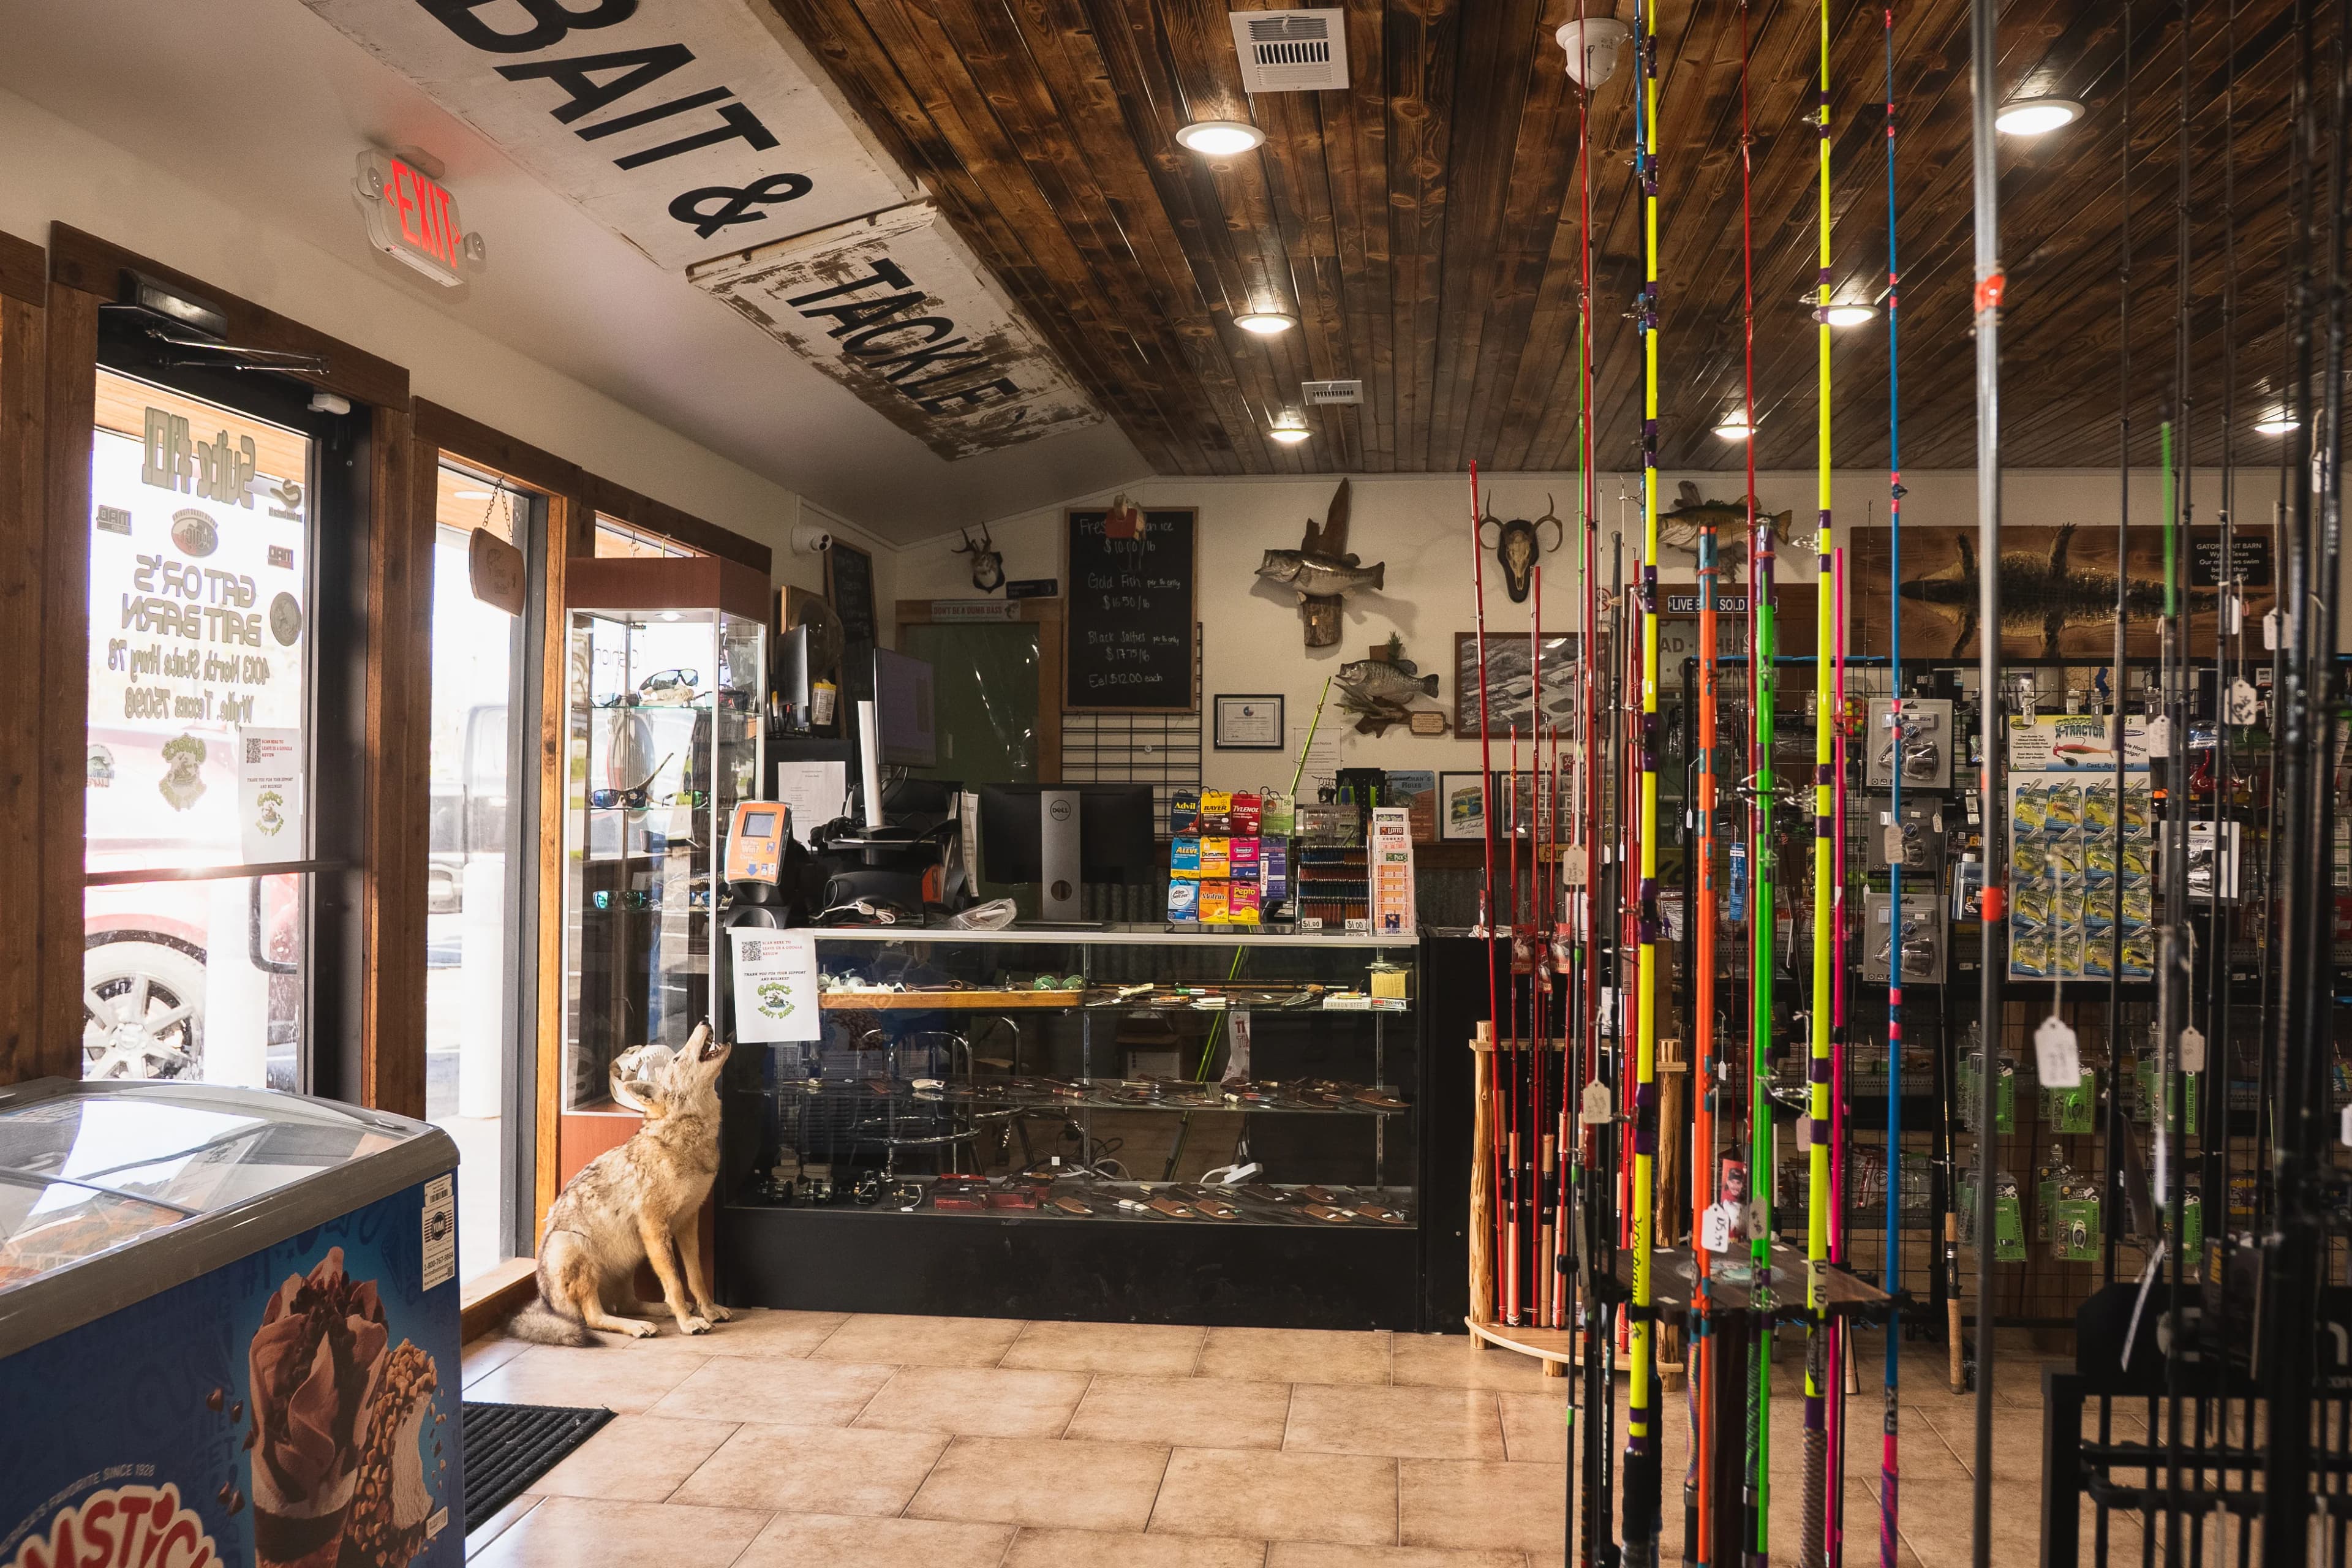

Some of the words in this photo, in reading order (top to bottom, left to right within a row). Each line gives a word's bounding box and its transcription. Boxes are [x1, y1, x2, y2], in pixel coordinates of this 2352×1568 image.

[431, 0, 782, 172] BAIT
[668, 172, 814, 239] &
[391, 159, 458, 268] EXIT
[785, 257, 1023, 421] TACKLE
[1080, 519, 1106, 536] Fres
[1088, 572, 1113, 589] Gold
[1121, 573, 1141, 587] Fish
[1673, 599, 1693, 611] LIVE
[1719, 599, 1745, 611] SOLD
[1088, 631, 1114, 644] Black
[1089, 674, 1107, 687] Eel
[1144, 673, 1163, 683] each
[1175, 801, 1196, 810] Advil
[1234, 887, 1256, 895] Pepto
[103, 1463, 133, 1481] SINCE
